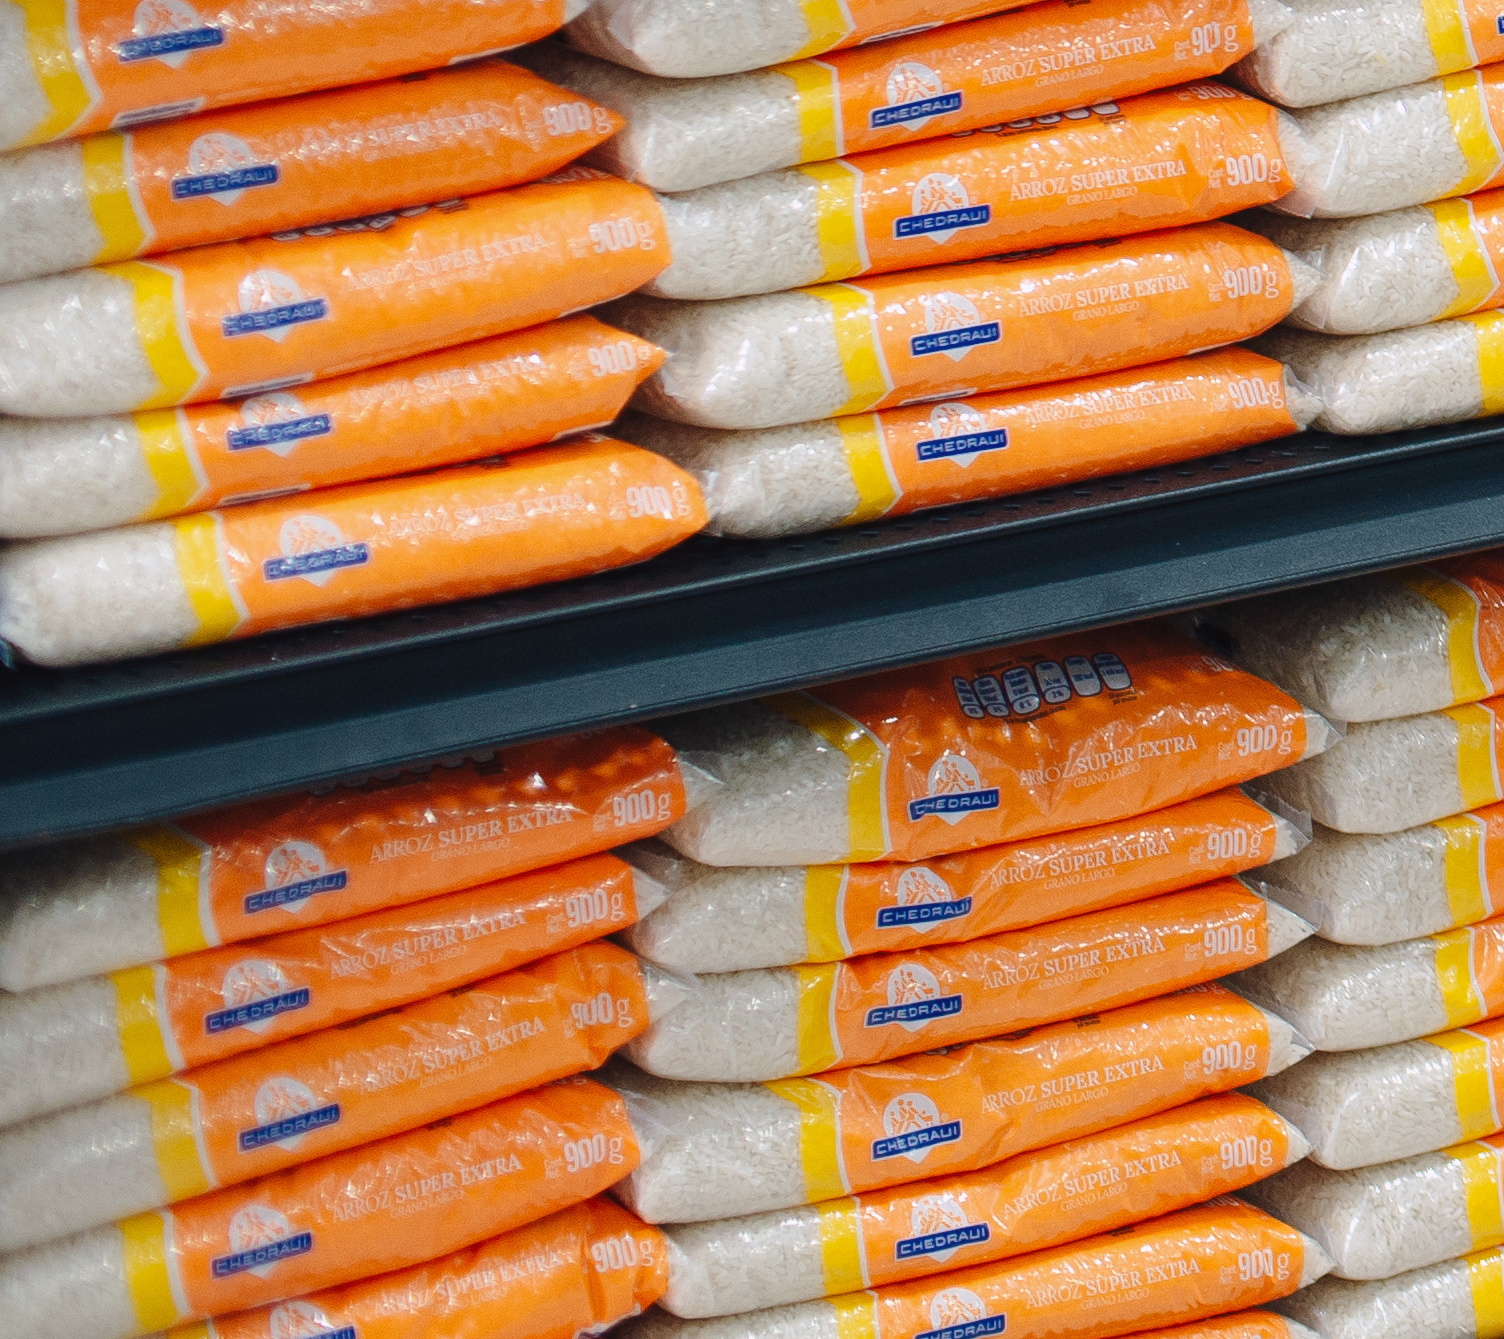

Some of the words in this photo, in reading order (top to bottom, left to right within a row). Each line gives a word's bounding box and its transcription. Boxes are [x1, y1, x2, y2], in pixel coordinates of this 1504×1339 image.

[913, 792, 995, 814] CHEDRAUI
[1039, 1071, 1098, 1100] SUPER
[1103, 1056, 1164, 1083] EXTRA
[874, 1127, 957, 1155] CHEDRAUI
